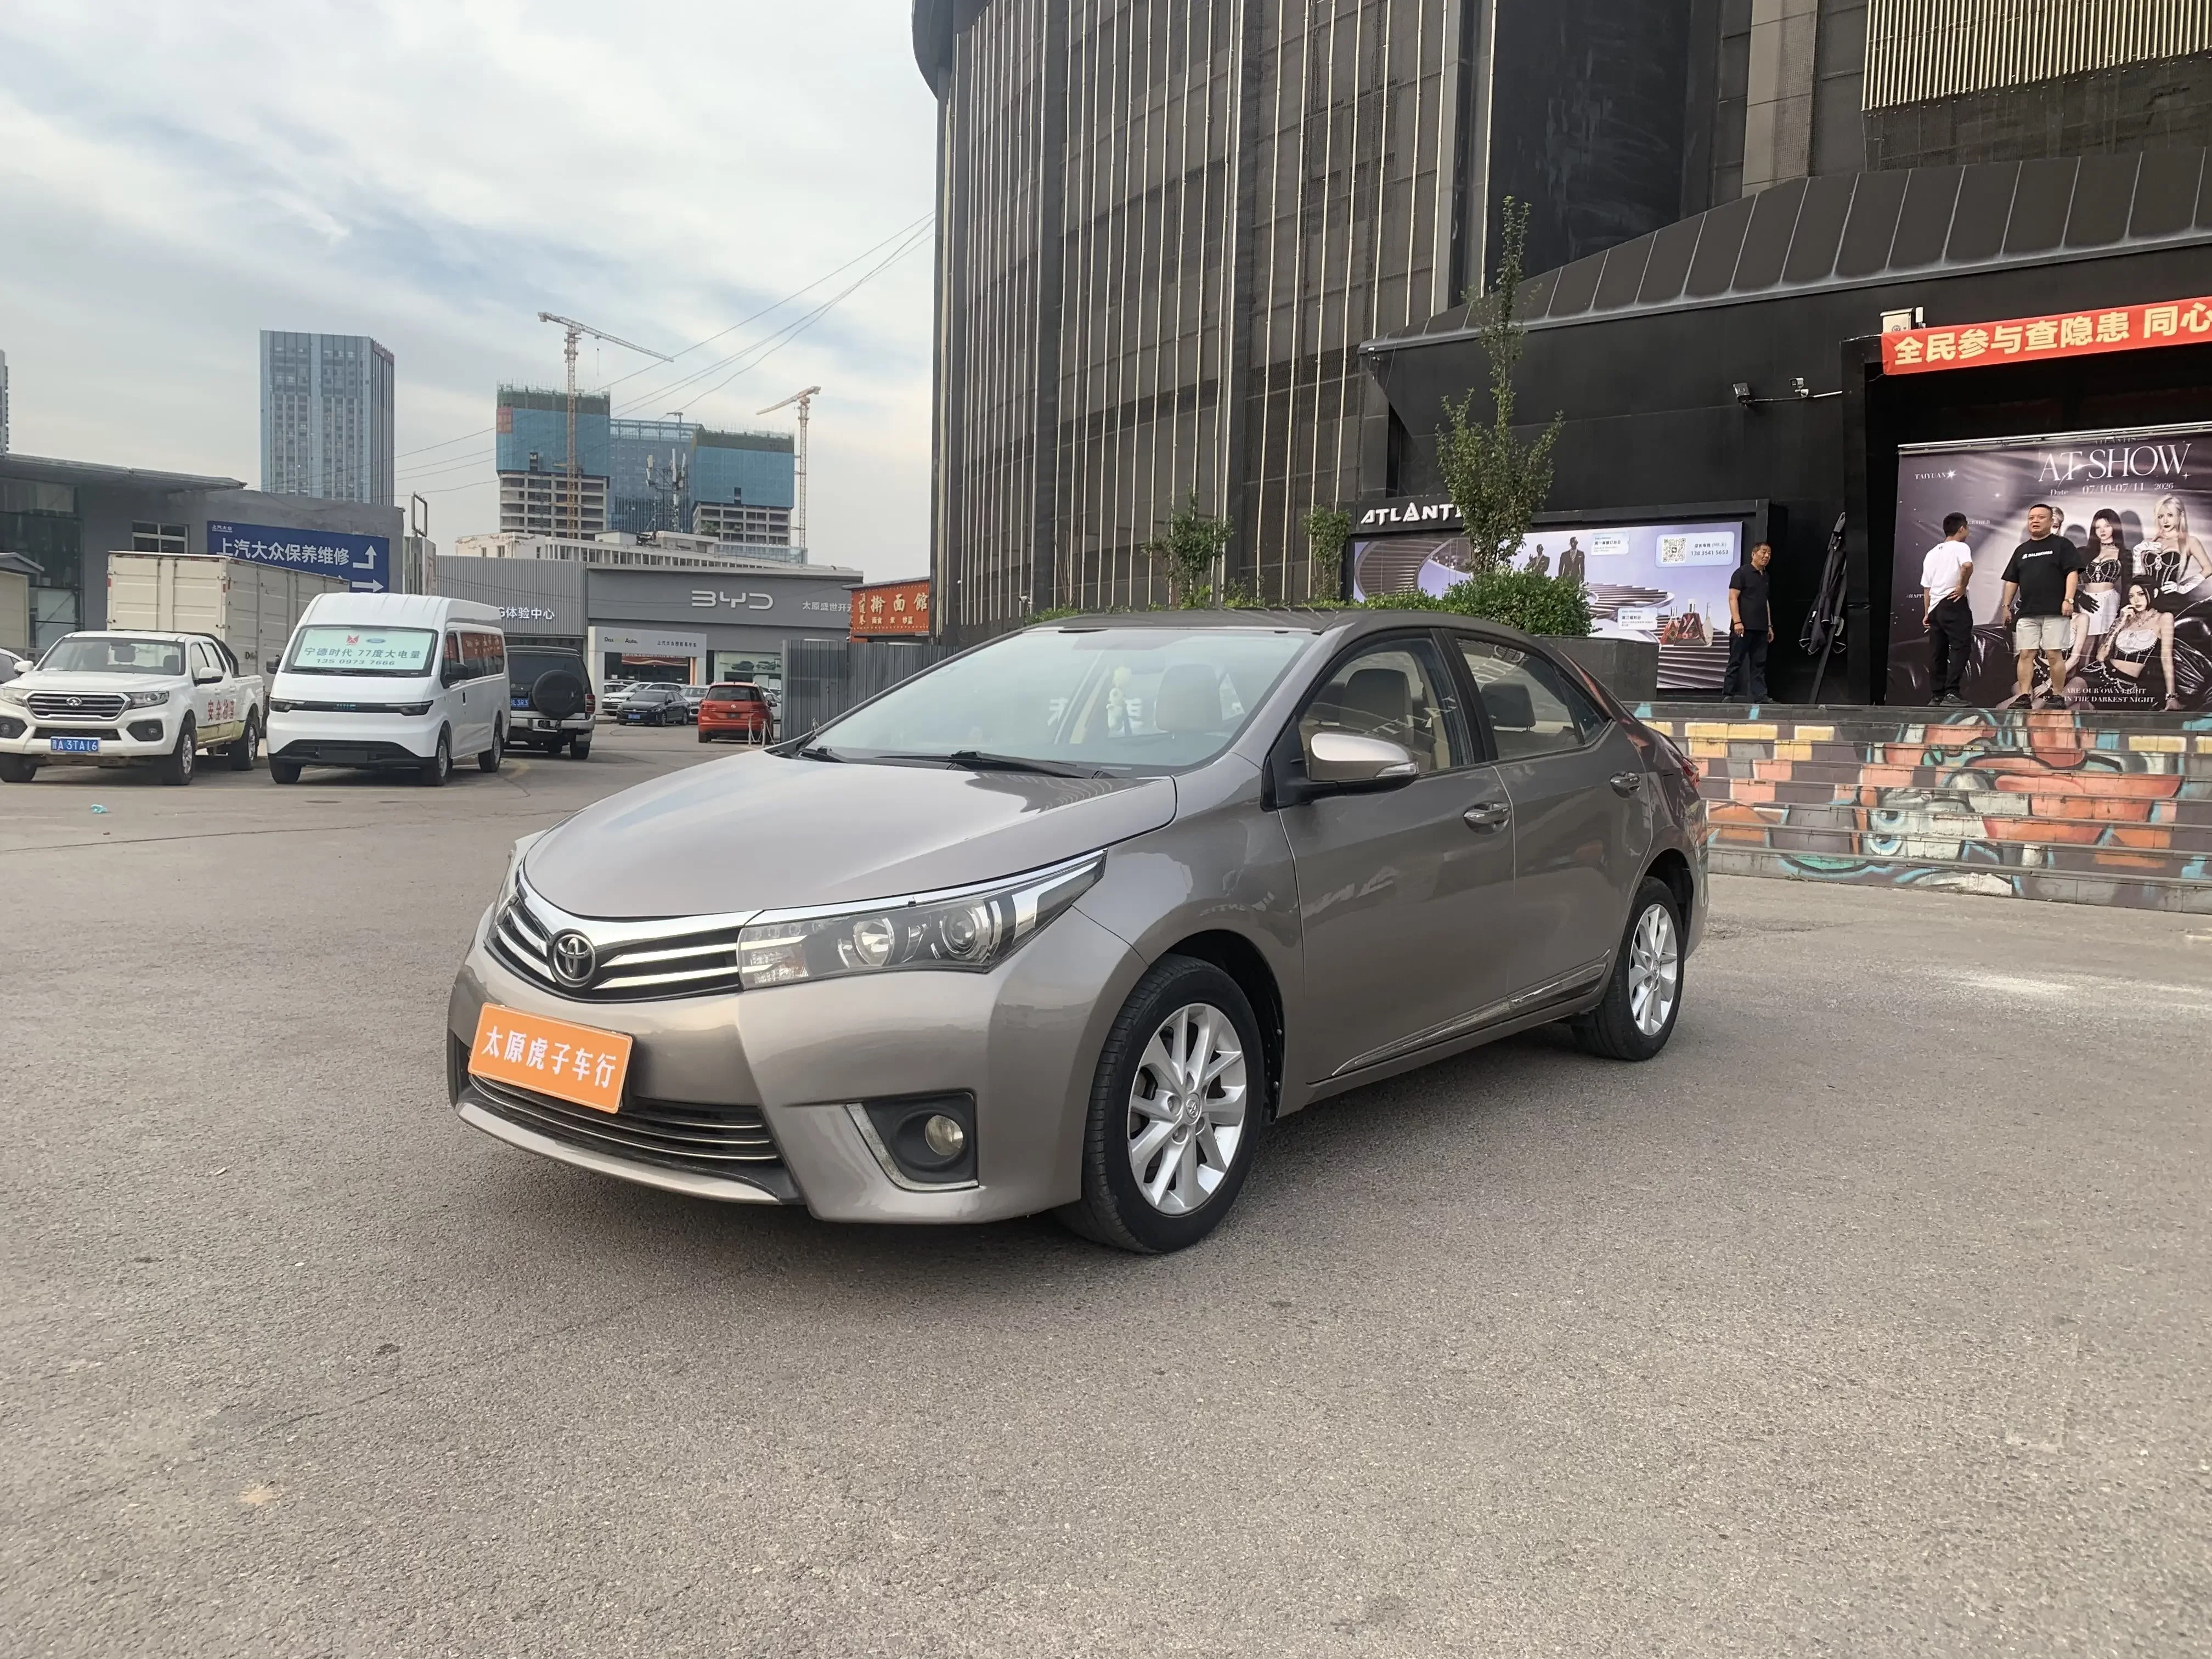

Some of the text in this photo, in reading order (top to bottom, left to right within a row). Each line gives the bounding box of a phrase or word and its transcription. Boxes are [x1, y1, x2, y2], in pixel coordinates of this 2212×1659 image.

[1894, 302, 2212, 365] 全民参与查隐患 同心
[2038, 443, 2192, 482] AT SHOW
[2154, 482, 2174, 490] 2026
[216, 537, 349, 566] 上汽大众保养维修
[692, 590, 774, 610] BYD
[304, 647, 422, 659] 宁德时代 77度大电量
[481, 1025, 618, 1088] 太原虎子车行
